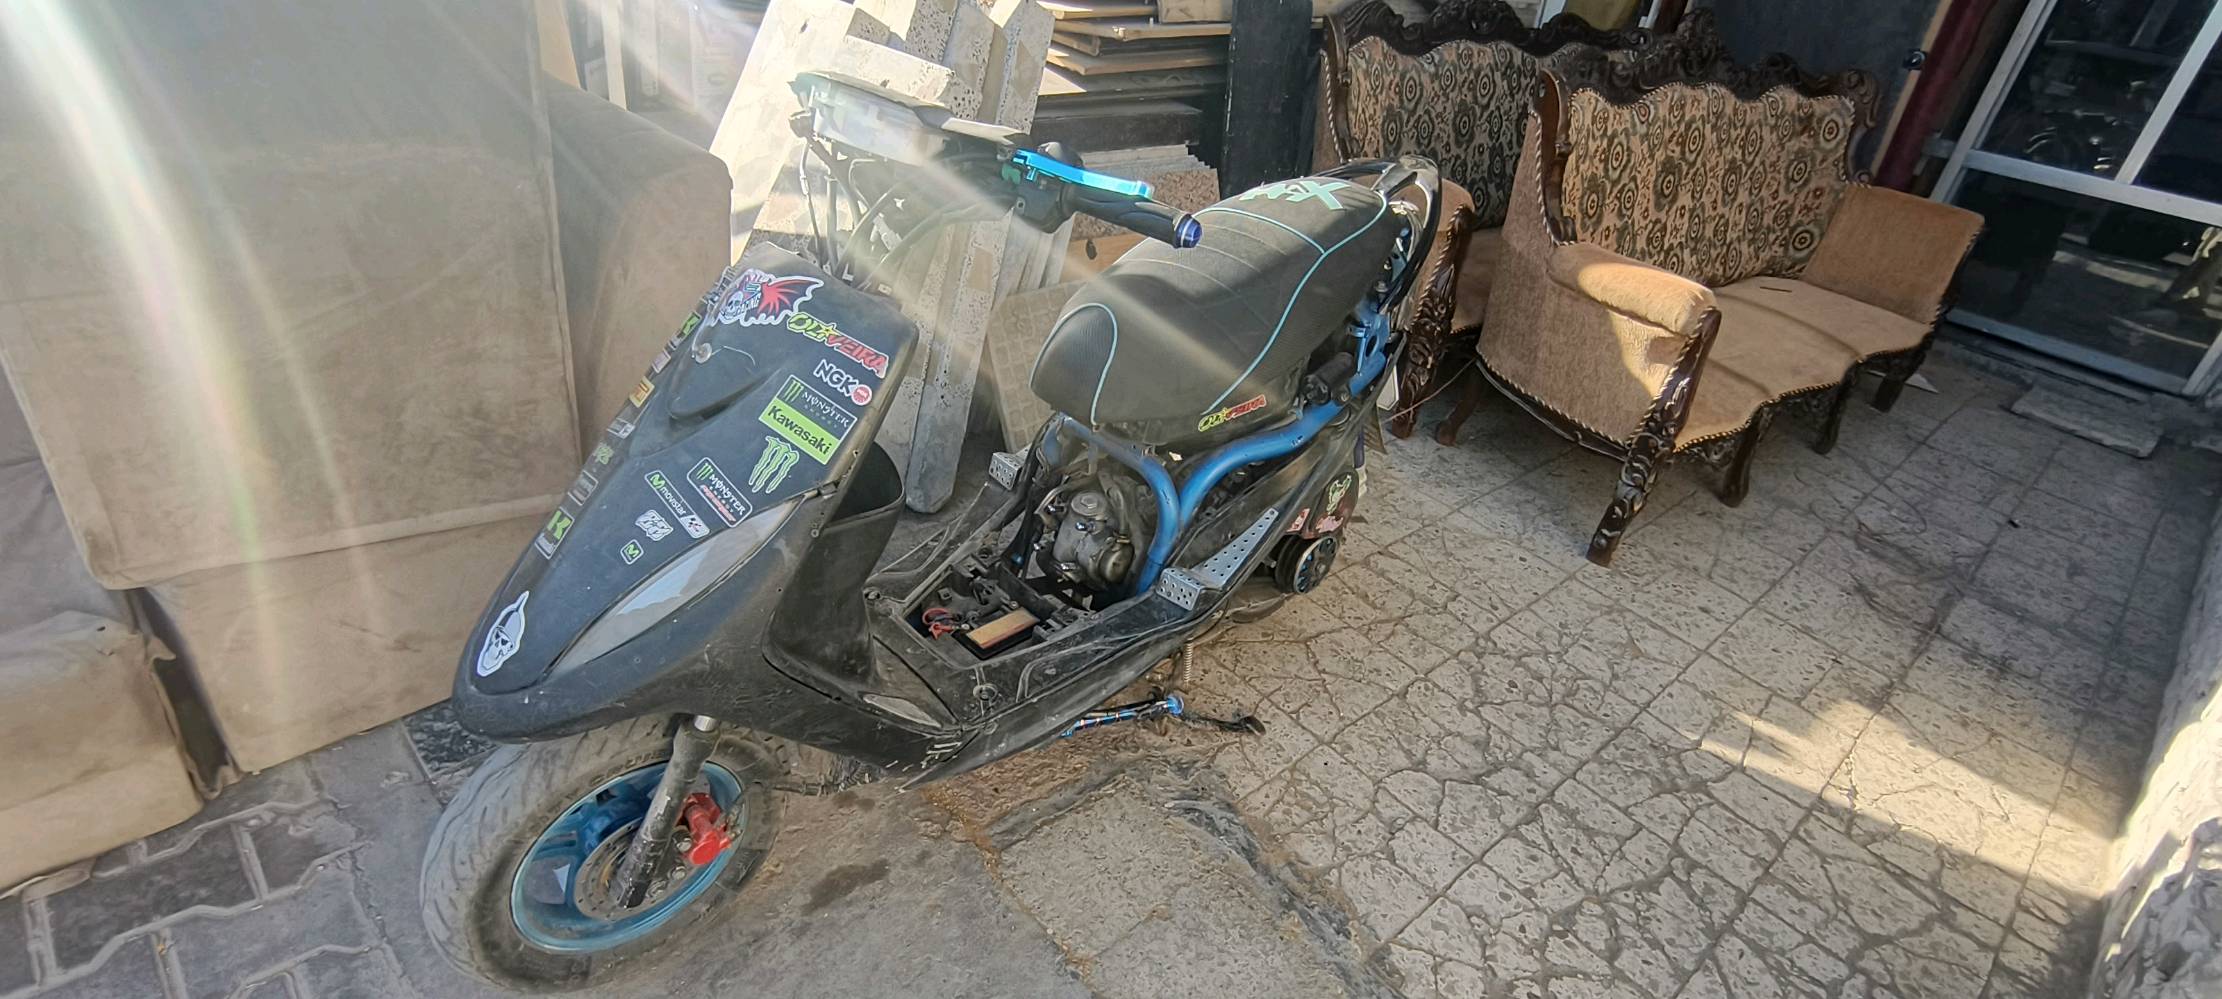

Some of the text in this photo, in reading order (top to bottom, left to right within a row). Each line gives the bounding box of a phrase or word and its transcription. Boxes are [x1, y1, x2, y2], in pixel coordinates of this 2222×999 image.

[813, 359, 860, 397] NGK
[801, 390, 849, 428] MONSTER
[767, 405, 833, 455] Kawasaki
[660, 486, 687, 516] movistar
[708, 473, 746, 516] MONSTER
